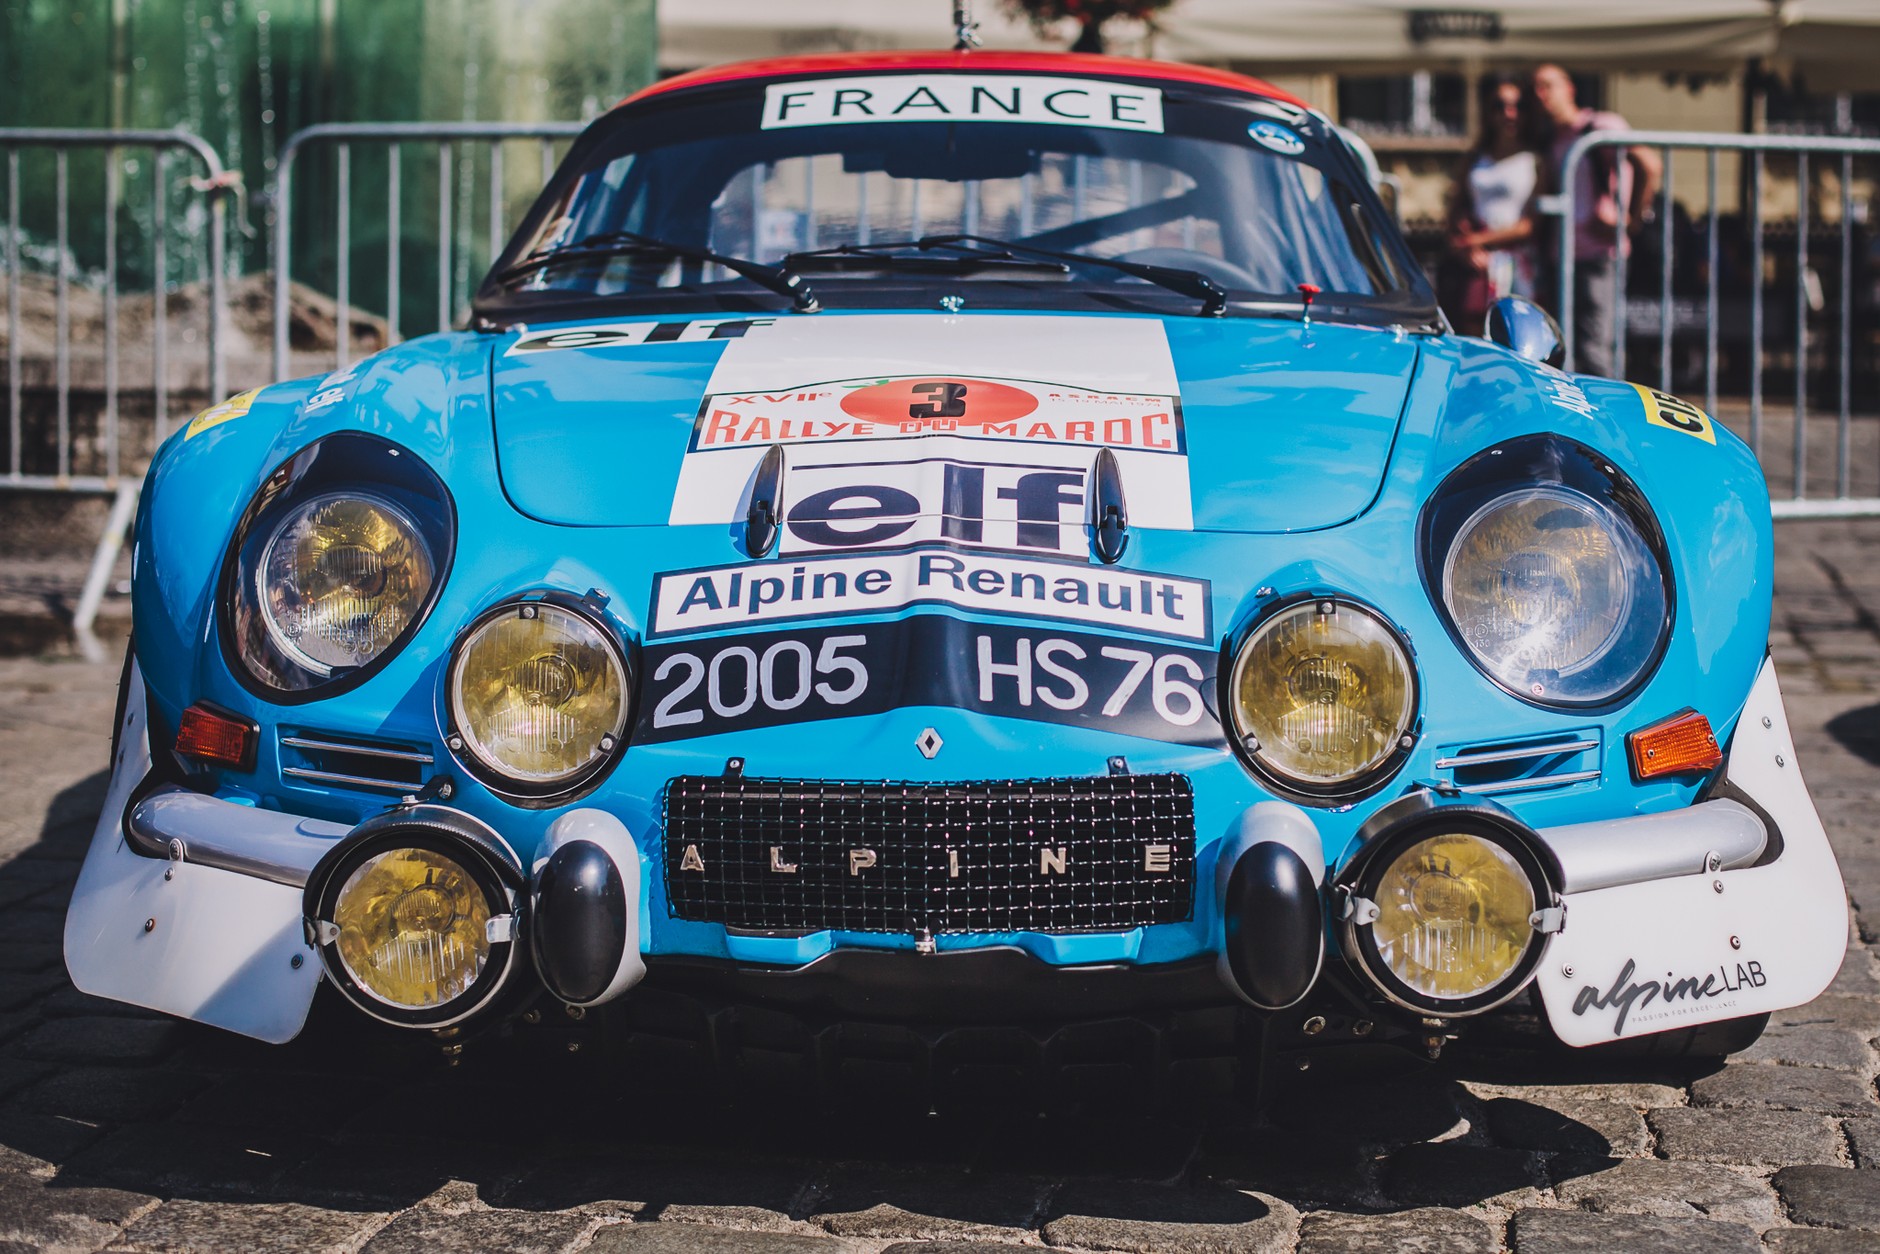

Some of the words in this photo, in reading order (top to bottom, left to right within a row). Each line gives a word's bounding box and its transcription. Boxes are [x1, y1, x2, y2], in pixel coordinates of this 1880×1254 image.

[777, 86, 1147, 125] FRANCE
[514, 319, 777, 350] elf
[909, 382, 967, 418] 3
[704, 409, 875, 445] RALLYE
[900, 420, 958, 433] DU
[982, 413, 1171, 449] MAROC
[787, 463, 1084, 550] elf
[677, 567, 892, 616] Alpine
[918, 555, 1184, 621] Renault
[653, 634, 869, 729] 2005
[977, 635, 1089, 711] HS
[1100, 646, 1205, 727] 76
[680, 844, 1171, 877] ALPINE
[1632, 1011, 1669, 1023] PASSION
[1672, 1008, 1687, 1017] FOR
